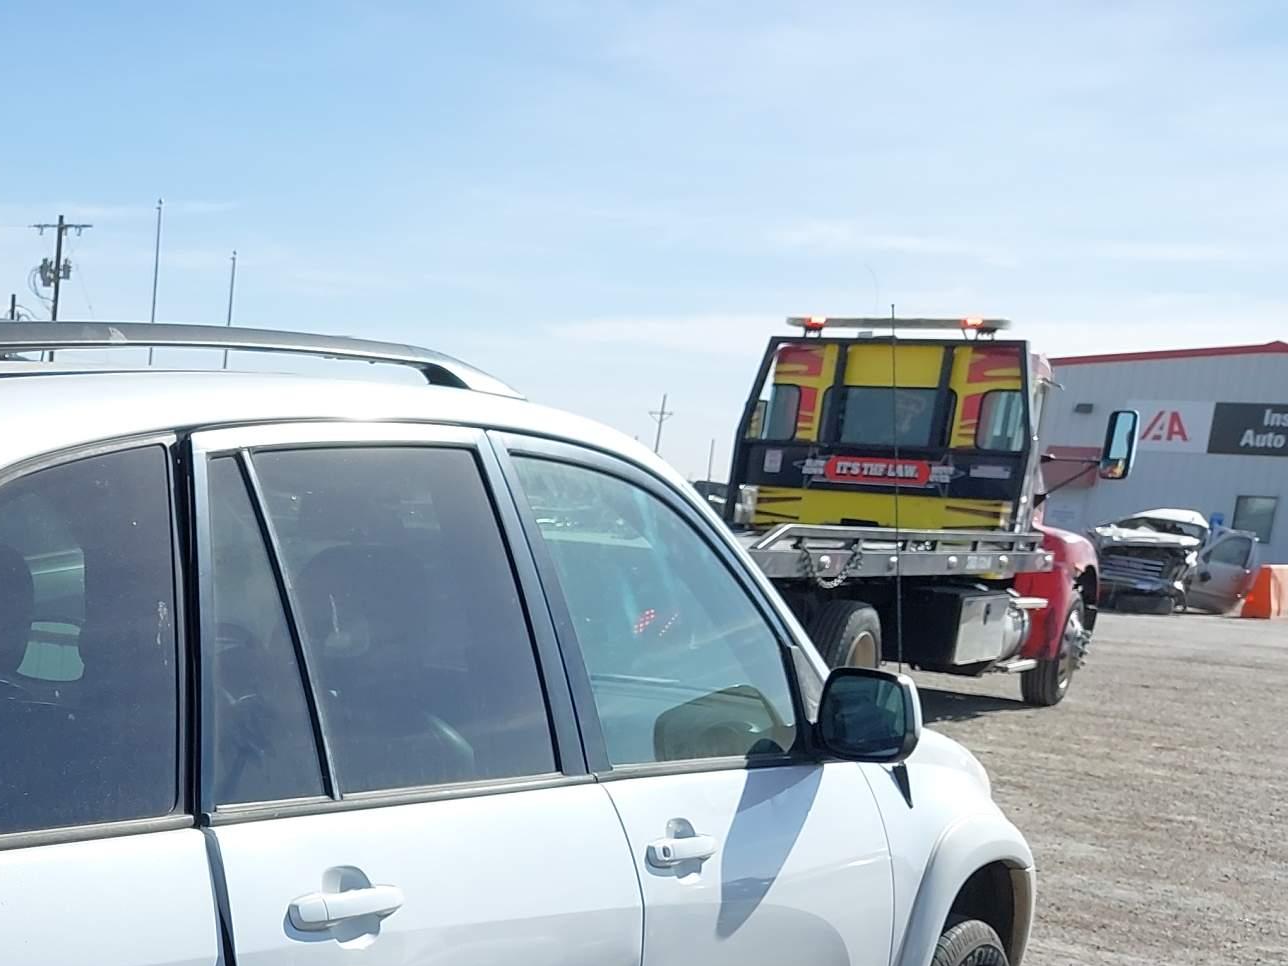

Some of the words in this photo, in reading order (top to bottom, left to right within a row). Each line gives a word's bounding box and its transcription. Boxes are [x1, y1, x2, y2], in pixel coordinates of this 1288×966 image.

[1240, 429, 1286, 448] Auto
[835, 460, 861, 475] IT'S
[862, 462, 887, 477] THE
